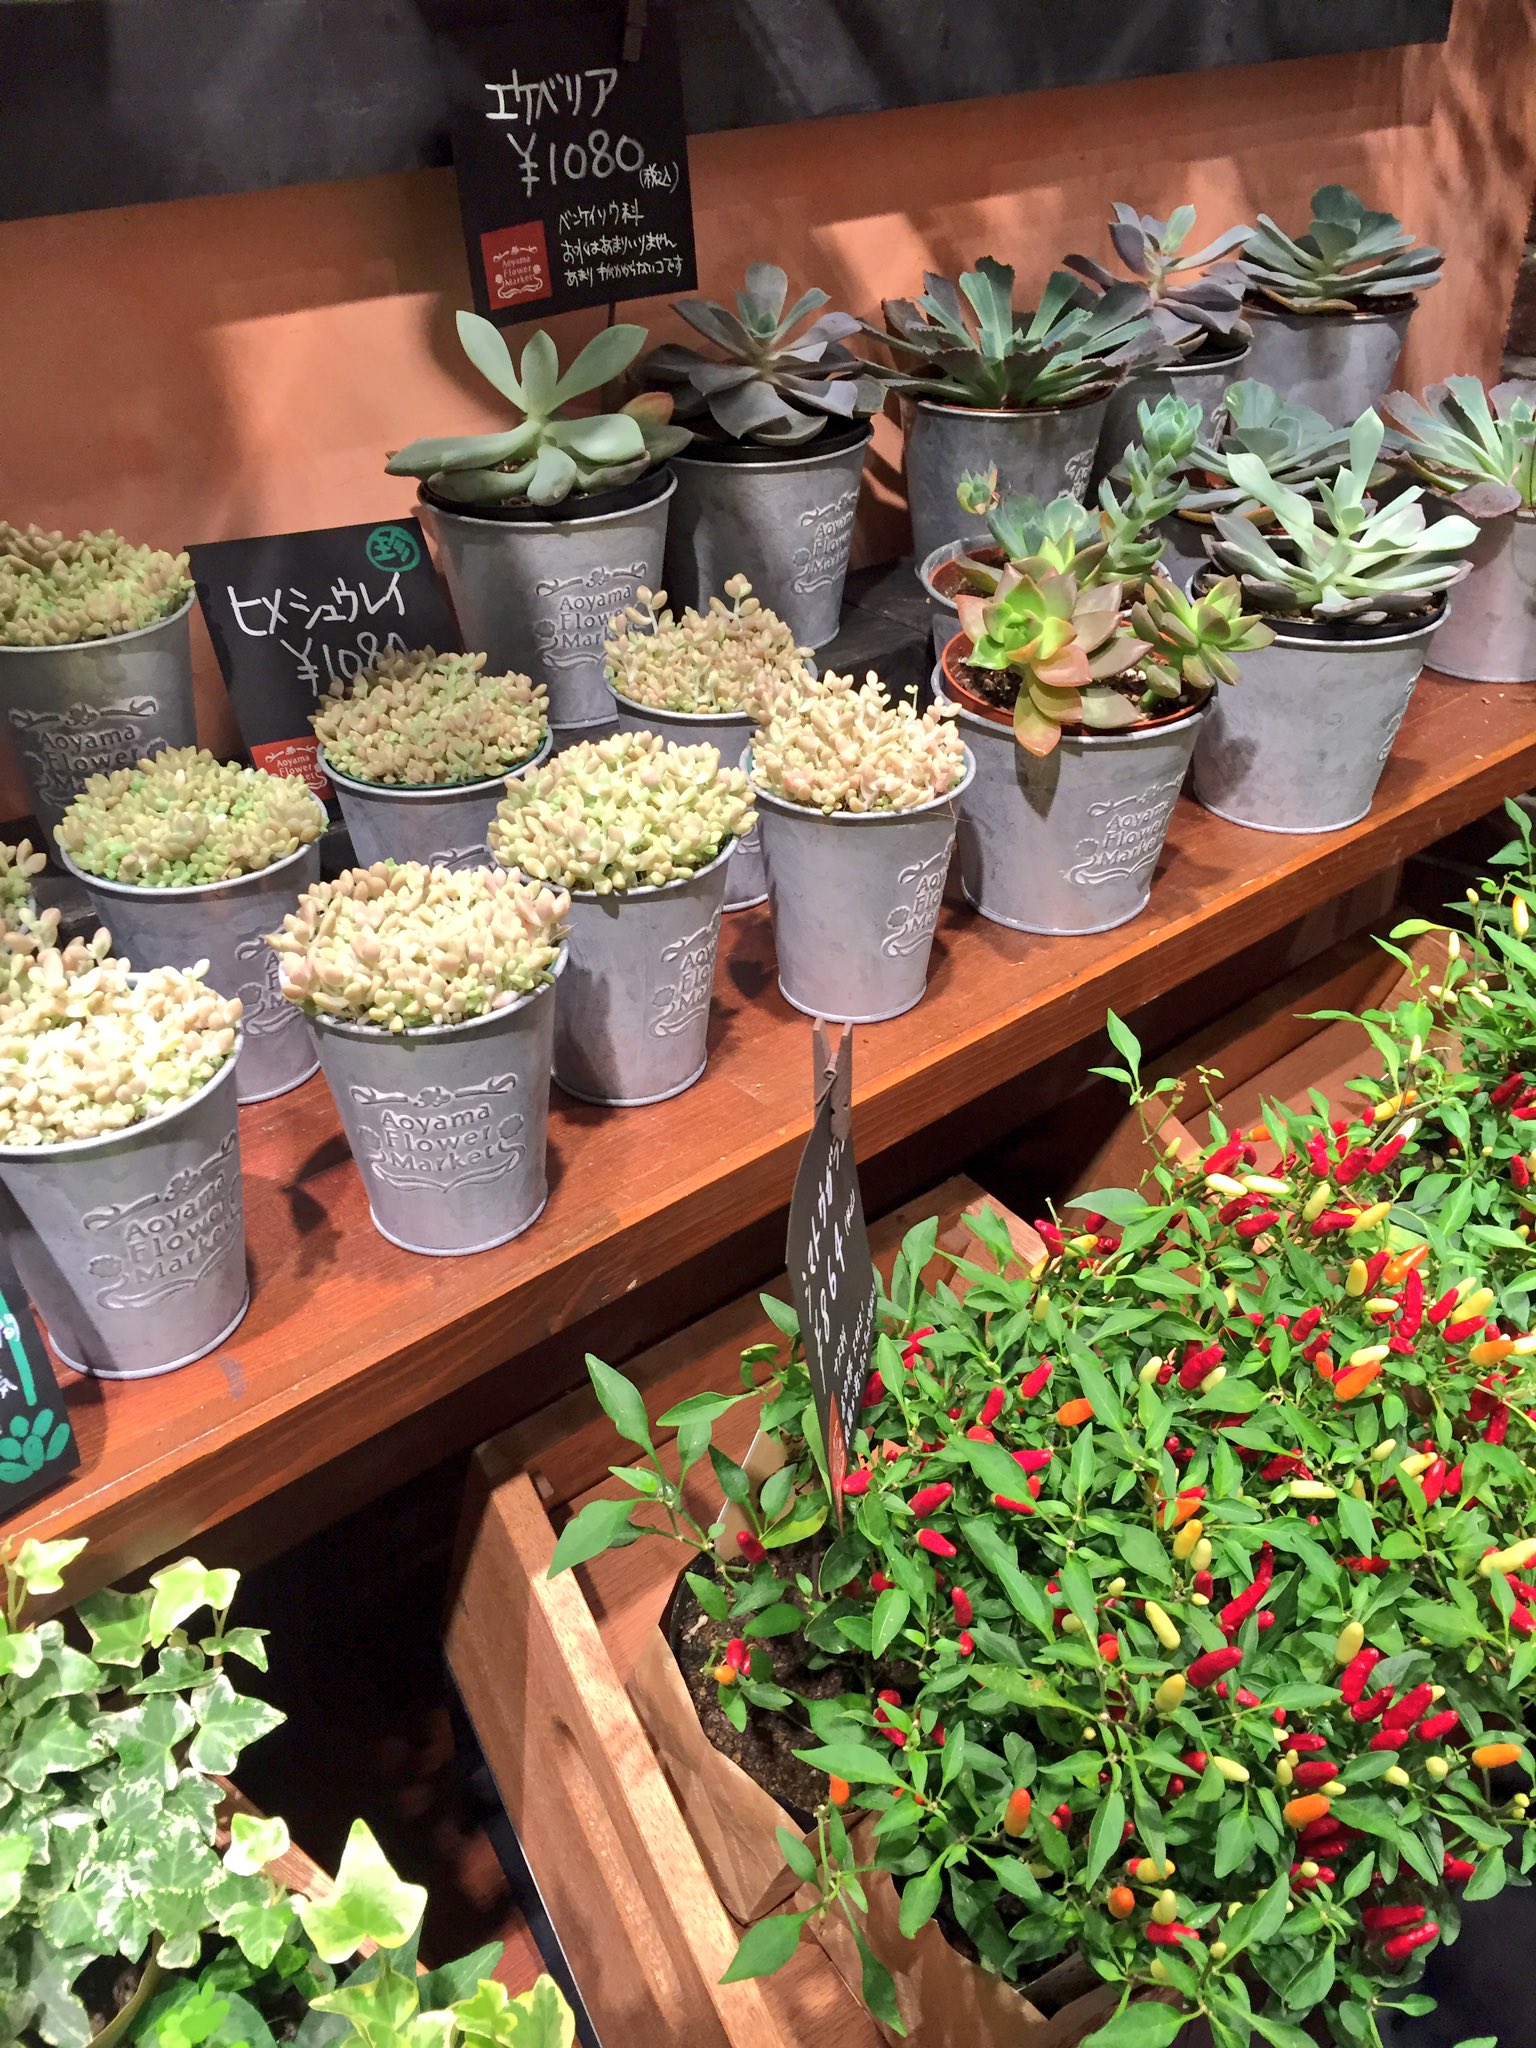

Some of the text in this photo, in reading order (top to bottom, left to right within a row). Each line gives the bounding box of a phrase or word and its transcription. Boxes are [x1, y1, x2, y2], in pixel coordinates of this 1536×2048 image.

[506, 129, 646, 198] ¥1080
[504, 266, 531, 278] Flower
[505, 274, 533, 286] Market
[559, 585, 632, 612] Aoyama
[560, 608, 624, 631] Flowe
[41, 726, 137, 752] Aoyama
[277, 754, 311, 767] Aoyama
[279, 764, 312, 777] Flower
[381, 1103, 492, 1135] Aoyama
[384, 1125, 491, 1152] Flower
[390, 1145, 494, 1172] Market
[125, 1171, 225, 1242] Aoyama
